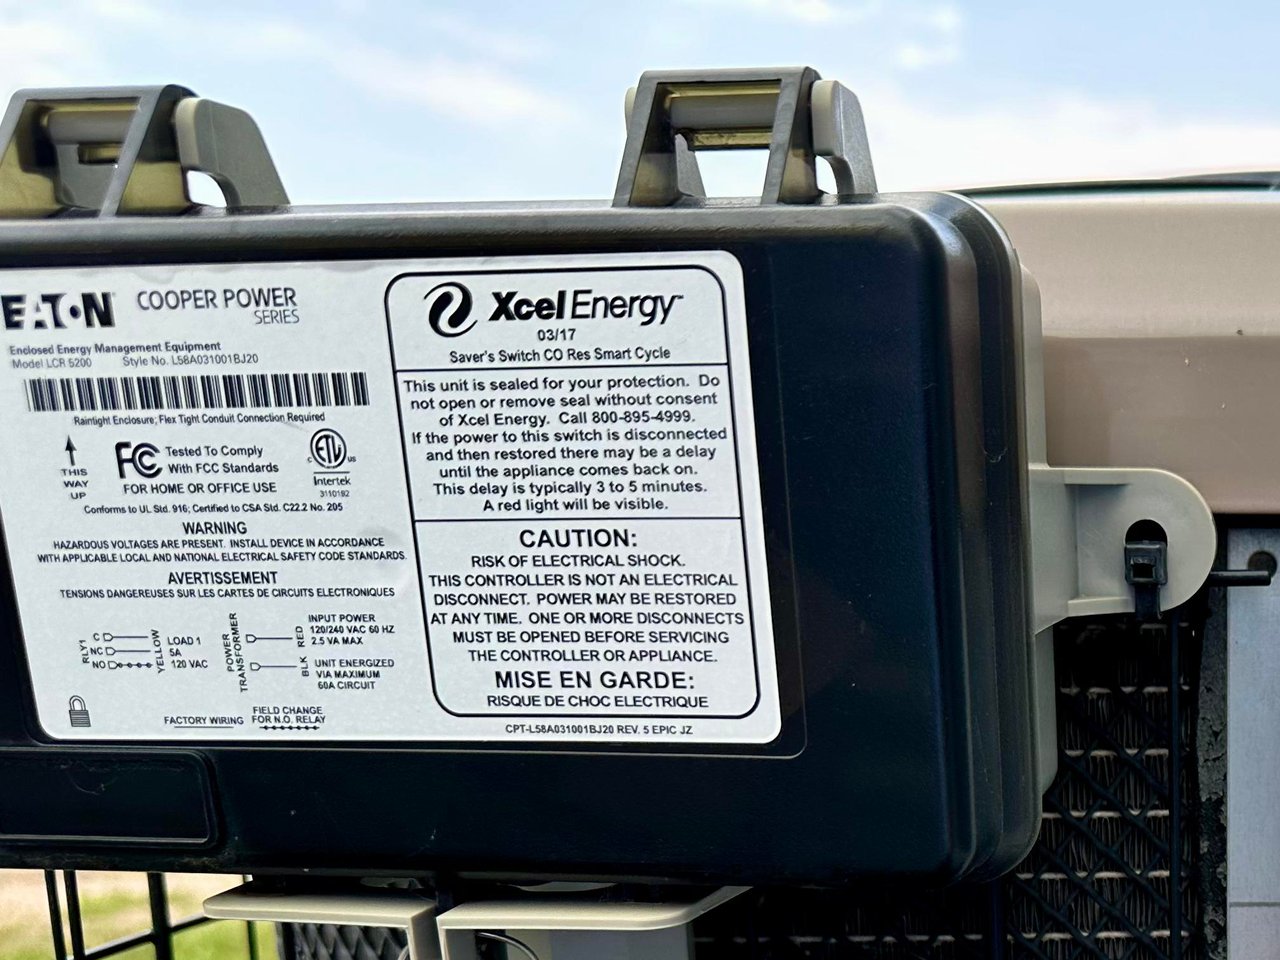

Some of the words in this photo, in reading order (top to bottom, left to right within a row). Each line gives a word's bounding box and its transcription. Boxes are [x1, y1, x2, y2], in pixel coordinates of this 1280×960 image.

[136, 289, 217, 310] COOPER
[222, 286, 297, 308] POWER
[253, 308, 299, 324] SERIES
[537, 327, 576, 341] 03/17
[9, 344, 54, 355] Enclosed
[56, 344, 91, 355] Energy
[94, 342, 162, 355] Management
[164, 341, 221, 353] Equipment
[498, 349, 540, 362] Switch
[543, 347, 563, 361] CO
[566, 348, 591, 360] Res
[593, 347, 631, 360] Smart
[634, 346, 670, 362] Cycle
[403, 379, 435, 392] This
[440, 378, 469, 391] unit
[472, 378, 485, 391] is
[489, 377, 538, 390] sealed
[542, 376, 564, 389] for
[568, 378, 602, 392] your
[607, 374, 689, 391] protection.
[698, 373, 720, 386] Do
[439, 413, 453, 426] of
[457, 413, 489, 426] Xcel
[493, 412, 549, 428] Energy.
[558, 411, 587, 424] Call
[591, 409, 695, 423] 800-895-4999.
[164, 445, 201, 456] Tested
[203, 445, 218, 456] To
[220, 445, 263, 458] Comply
[167, 463, 192, 473] With
[195, 462, 219, 473] FCC
[222, 462, 279, 473] Standards
[123, 483, 147, 494] FOR
[150, 483, 184, 494] HOME
[187, 482, 204, 493] OR
[207, 482, 250, 493] OFFICE
[252, 481, 276, 493] USE
[313, 476, 351, 486] Intertek
[483, 499, 494, 511] A
[497, 498, 521, 511] red
[525, 498, 559, 513] light
[562, 497, 587, 510] will
[592, 497, 610, 510] be
[614, 497, 668, 509] visible.
[182, 521, 247, 534] WARNING
[519, 528, 636, 547] CAUTION:
[471, 555, 505, 567] RISK
[508, 554, 528, 567] OF
[532, 554, 624, 567] ELECTRICAL
[627, 553, 685, 566] SHOCK.
[168, 571, 277, 584] AVERTISSEMENT
[167, 636, 193, 645] LOAD
[195, 636, 200, 644] 1
[151, 629, 163, 673] YELLOW
[169, 648, 182, 657] 5A
[170, 659, 186, 668] 120
[188, 659, 208, 668] VAC
[494, 670, 552, 688] MISE
[559, 670, 591, 688] EN
[599, 670, 694, 689] GARDE:
